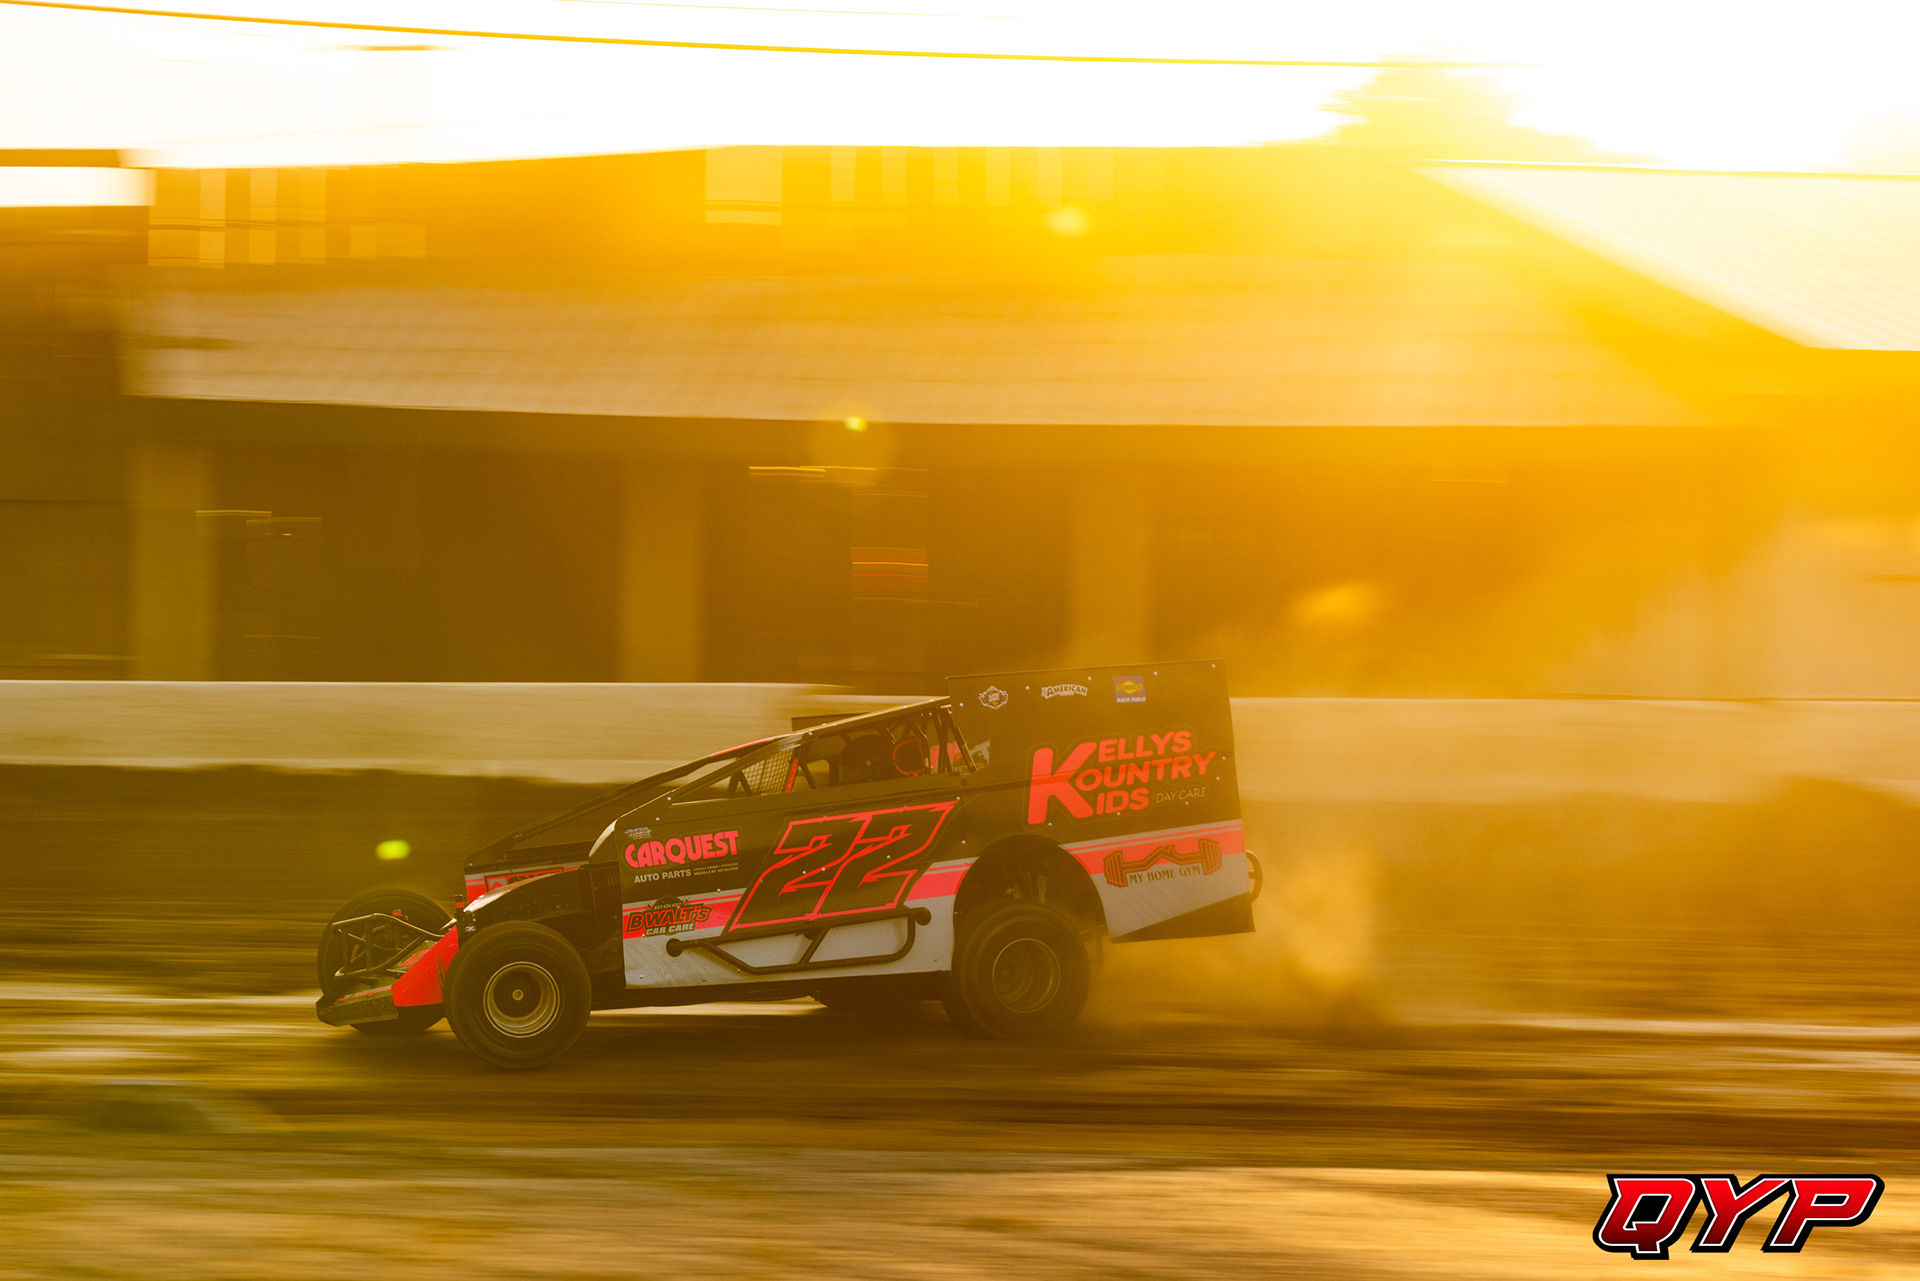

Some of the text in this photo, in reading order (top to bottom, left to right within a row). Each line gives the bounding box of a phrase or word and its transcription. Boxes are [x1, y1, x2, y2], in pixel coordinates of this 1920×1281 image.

[1046, 684, 1087, 697] AMERICAN
[1156, 786, 1207, 803] DAY CARE
[625, 830, 739, 868] CARQUEST
[728, 800, 959, 932] 22
[1129, 865, 1201, 884] MY HOME GYM
[634, 869, 692, 883] AUTO PARTS
[646, 922, 695, 936] CAR CARE
